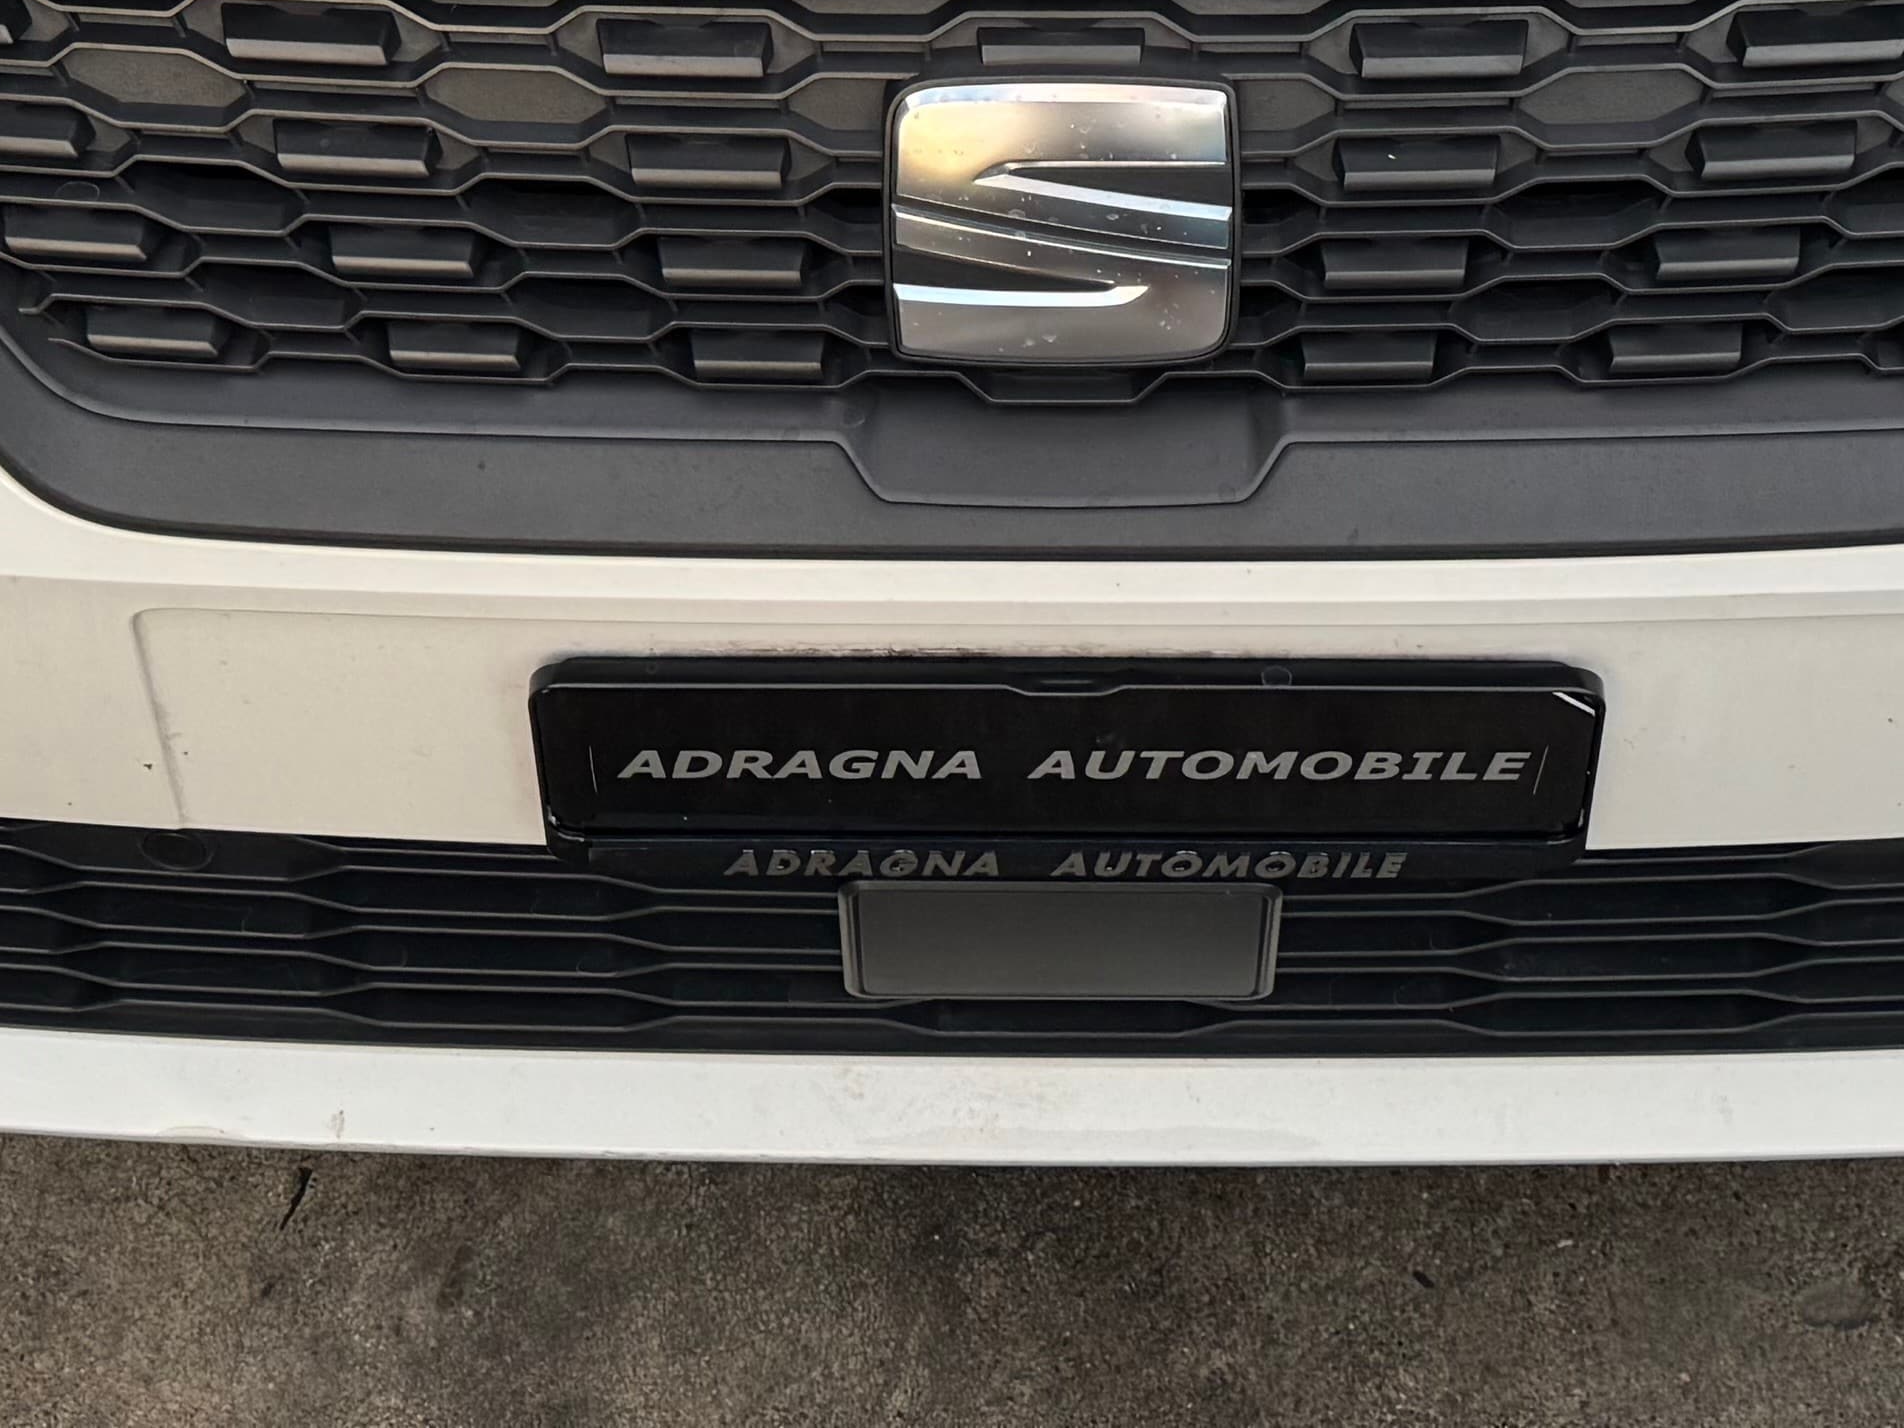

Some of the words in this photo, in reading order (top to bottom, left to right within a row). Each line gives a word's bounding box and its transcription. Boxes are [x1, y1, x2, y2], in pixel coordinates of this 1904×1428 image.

[617, 749, 983, 780] ADRAGNA
[1027, 750, 1533, 781] AUTOMOBILE
[723, 849, 999, 878] ADRAGNA
[1051, 849, 1408, 880] AUTOMOBILE
